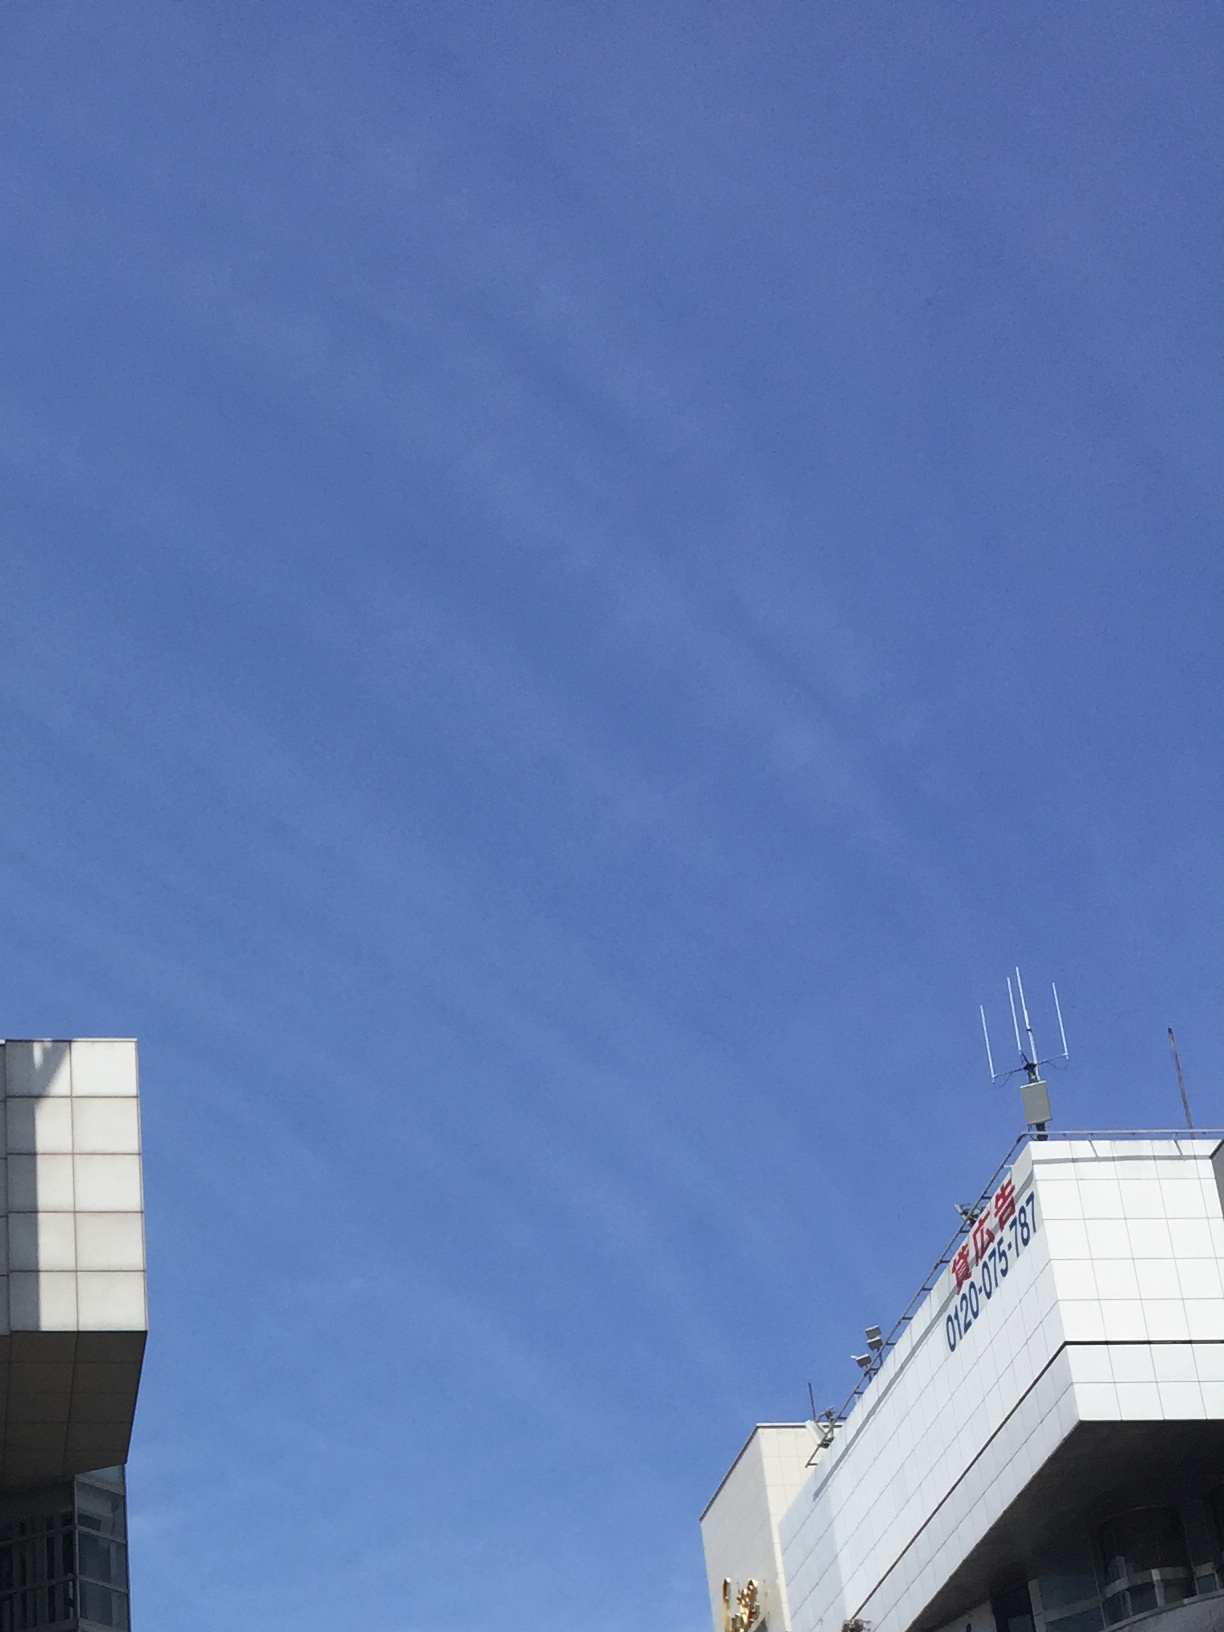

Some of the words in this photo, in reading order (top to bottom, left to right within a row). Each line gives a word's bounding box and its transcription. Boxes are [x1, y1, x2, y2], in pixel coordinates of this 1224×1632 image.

[945, 1191, 1037, 1352] 0120-075-787
[952, 1178, 1016, 1296] 貸広告
